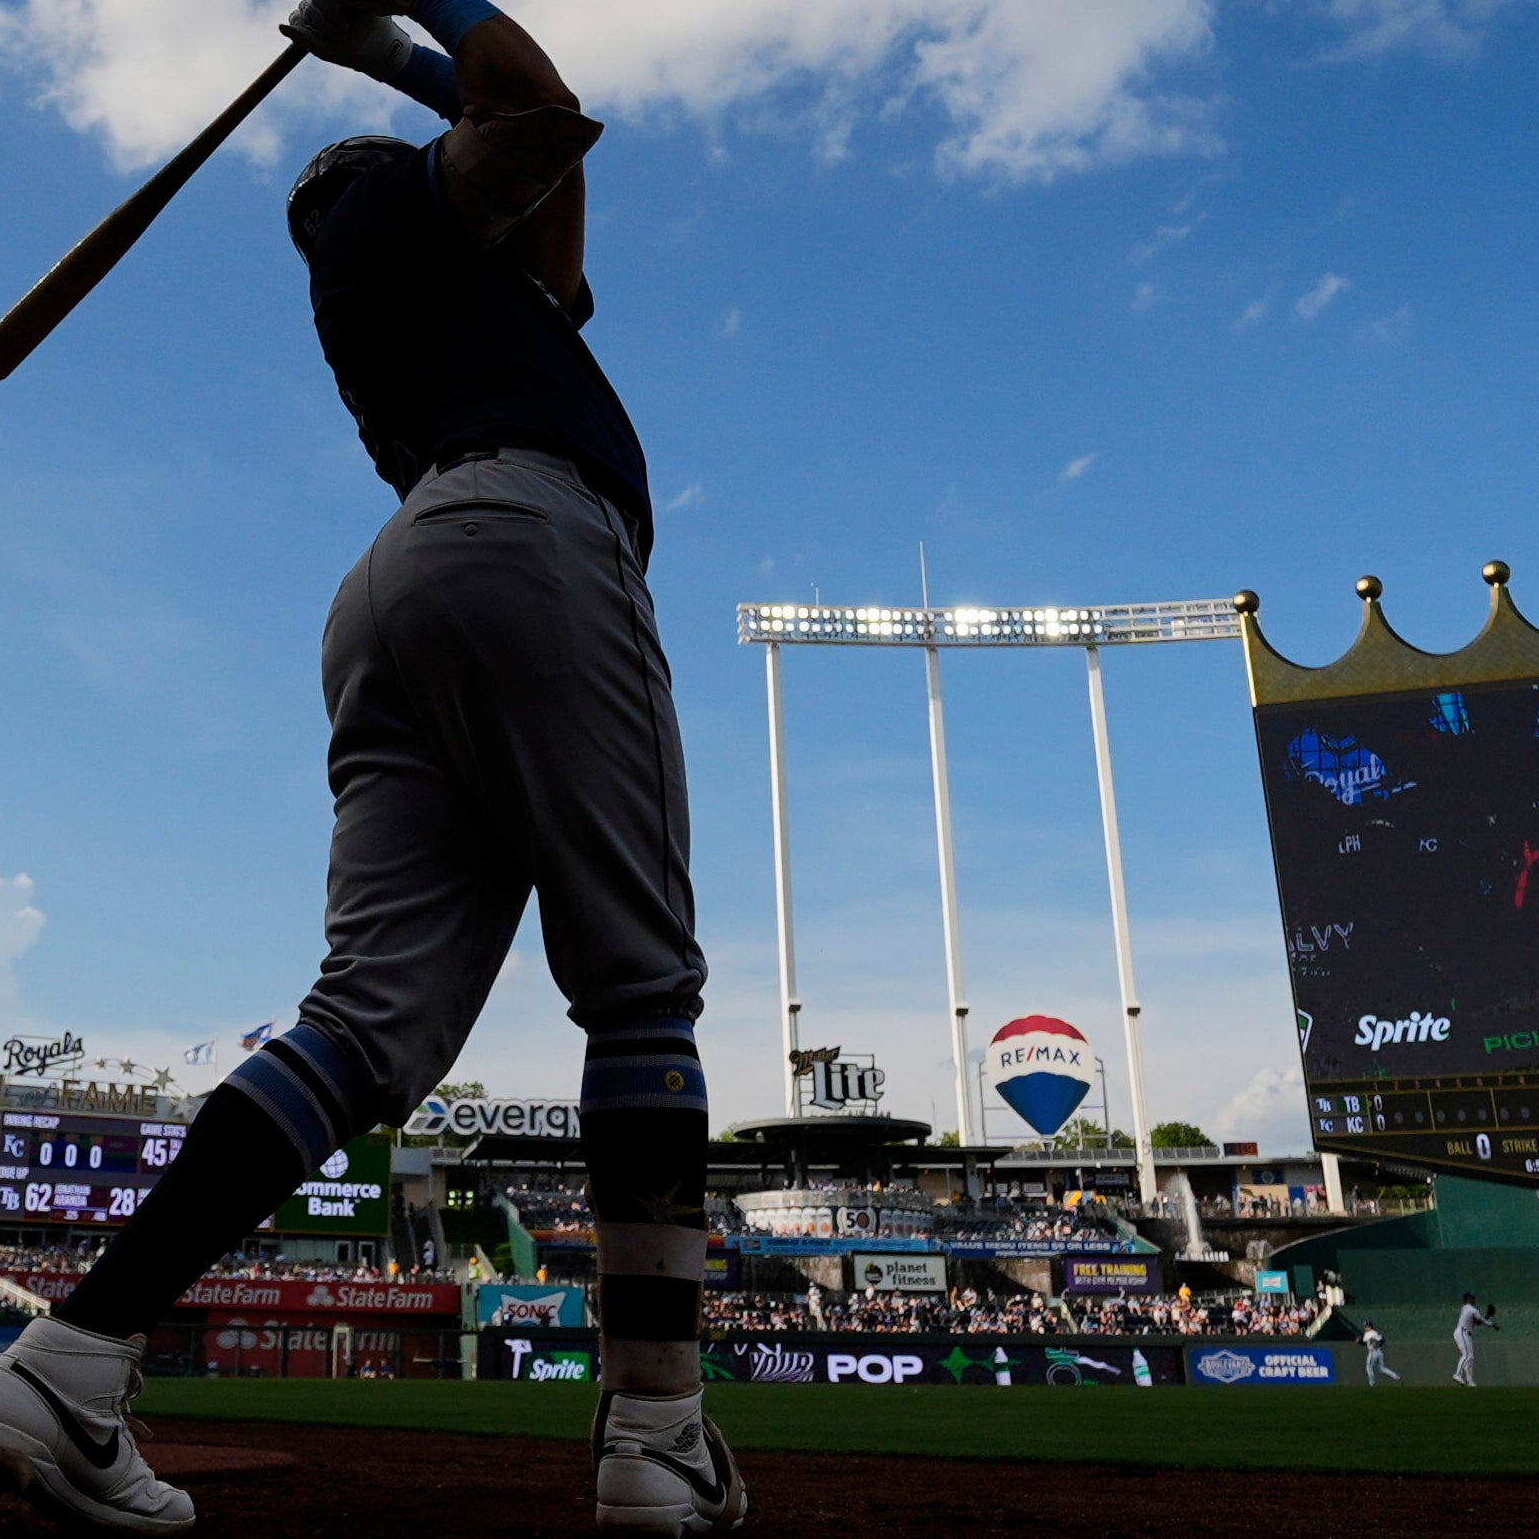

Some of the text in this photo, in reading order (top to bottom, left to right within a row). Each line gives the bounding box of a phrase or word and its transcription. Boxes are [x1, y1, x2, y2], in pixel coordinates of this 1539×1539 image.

[1354, 1011, 1451, 1052] Sprite
[3, 1031, 85, 1075] Royals
[1001, 1046, 1080, 1068] RE/MAX
[62, 1079, 159, 1110] FAME
[810, 1061, 885, 1110] Lite
[1343, 1095, 1362, 1113] TB
[1373, 1094, 1383, 1111] 0
[1346, 1116, 1364, 1134] KC
[1376, 1113, 1386, 1131] 0
[39, 1142, 103, 1169] 0 0 0
[141, 1139, 169, 1166] 45
[1446, 1141, 1473, 1156] BALL
[1475, 1133, 1492, 1160] 0
[1502, 1138, 1539, 1155] STRIKE
[25, 1183, 53, 1212] 62
[109, 1187, 136, 1216] 28
[308, 1197, 355, 1217] Bank
[985, 1241, 1015, 1250] MENU
[1017, 1241, 1049, 1250] ITEMS
[1067, 1242, 1082, 1251] OR
[1084, 1242, 1110, 1251] LESS
[886, 1261, 927, 1275] planet
[892, 1273, 936, 1286] fitness
[1073, 1263, 1147, 1276] FREE TRAINING
[508, 1304, 557, 1321] SONIC
[529, 1358, 586, 1382] Sprite
[827, 1353, 923, 1384] POP
[1259, 1366, 1296, 1378] CRAFT
[1298, 1366, 1329, 1378] BEER
[1264, 1354, 1317, 1367] OFFICIAL
